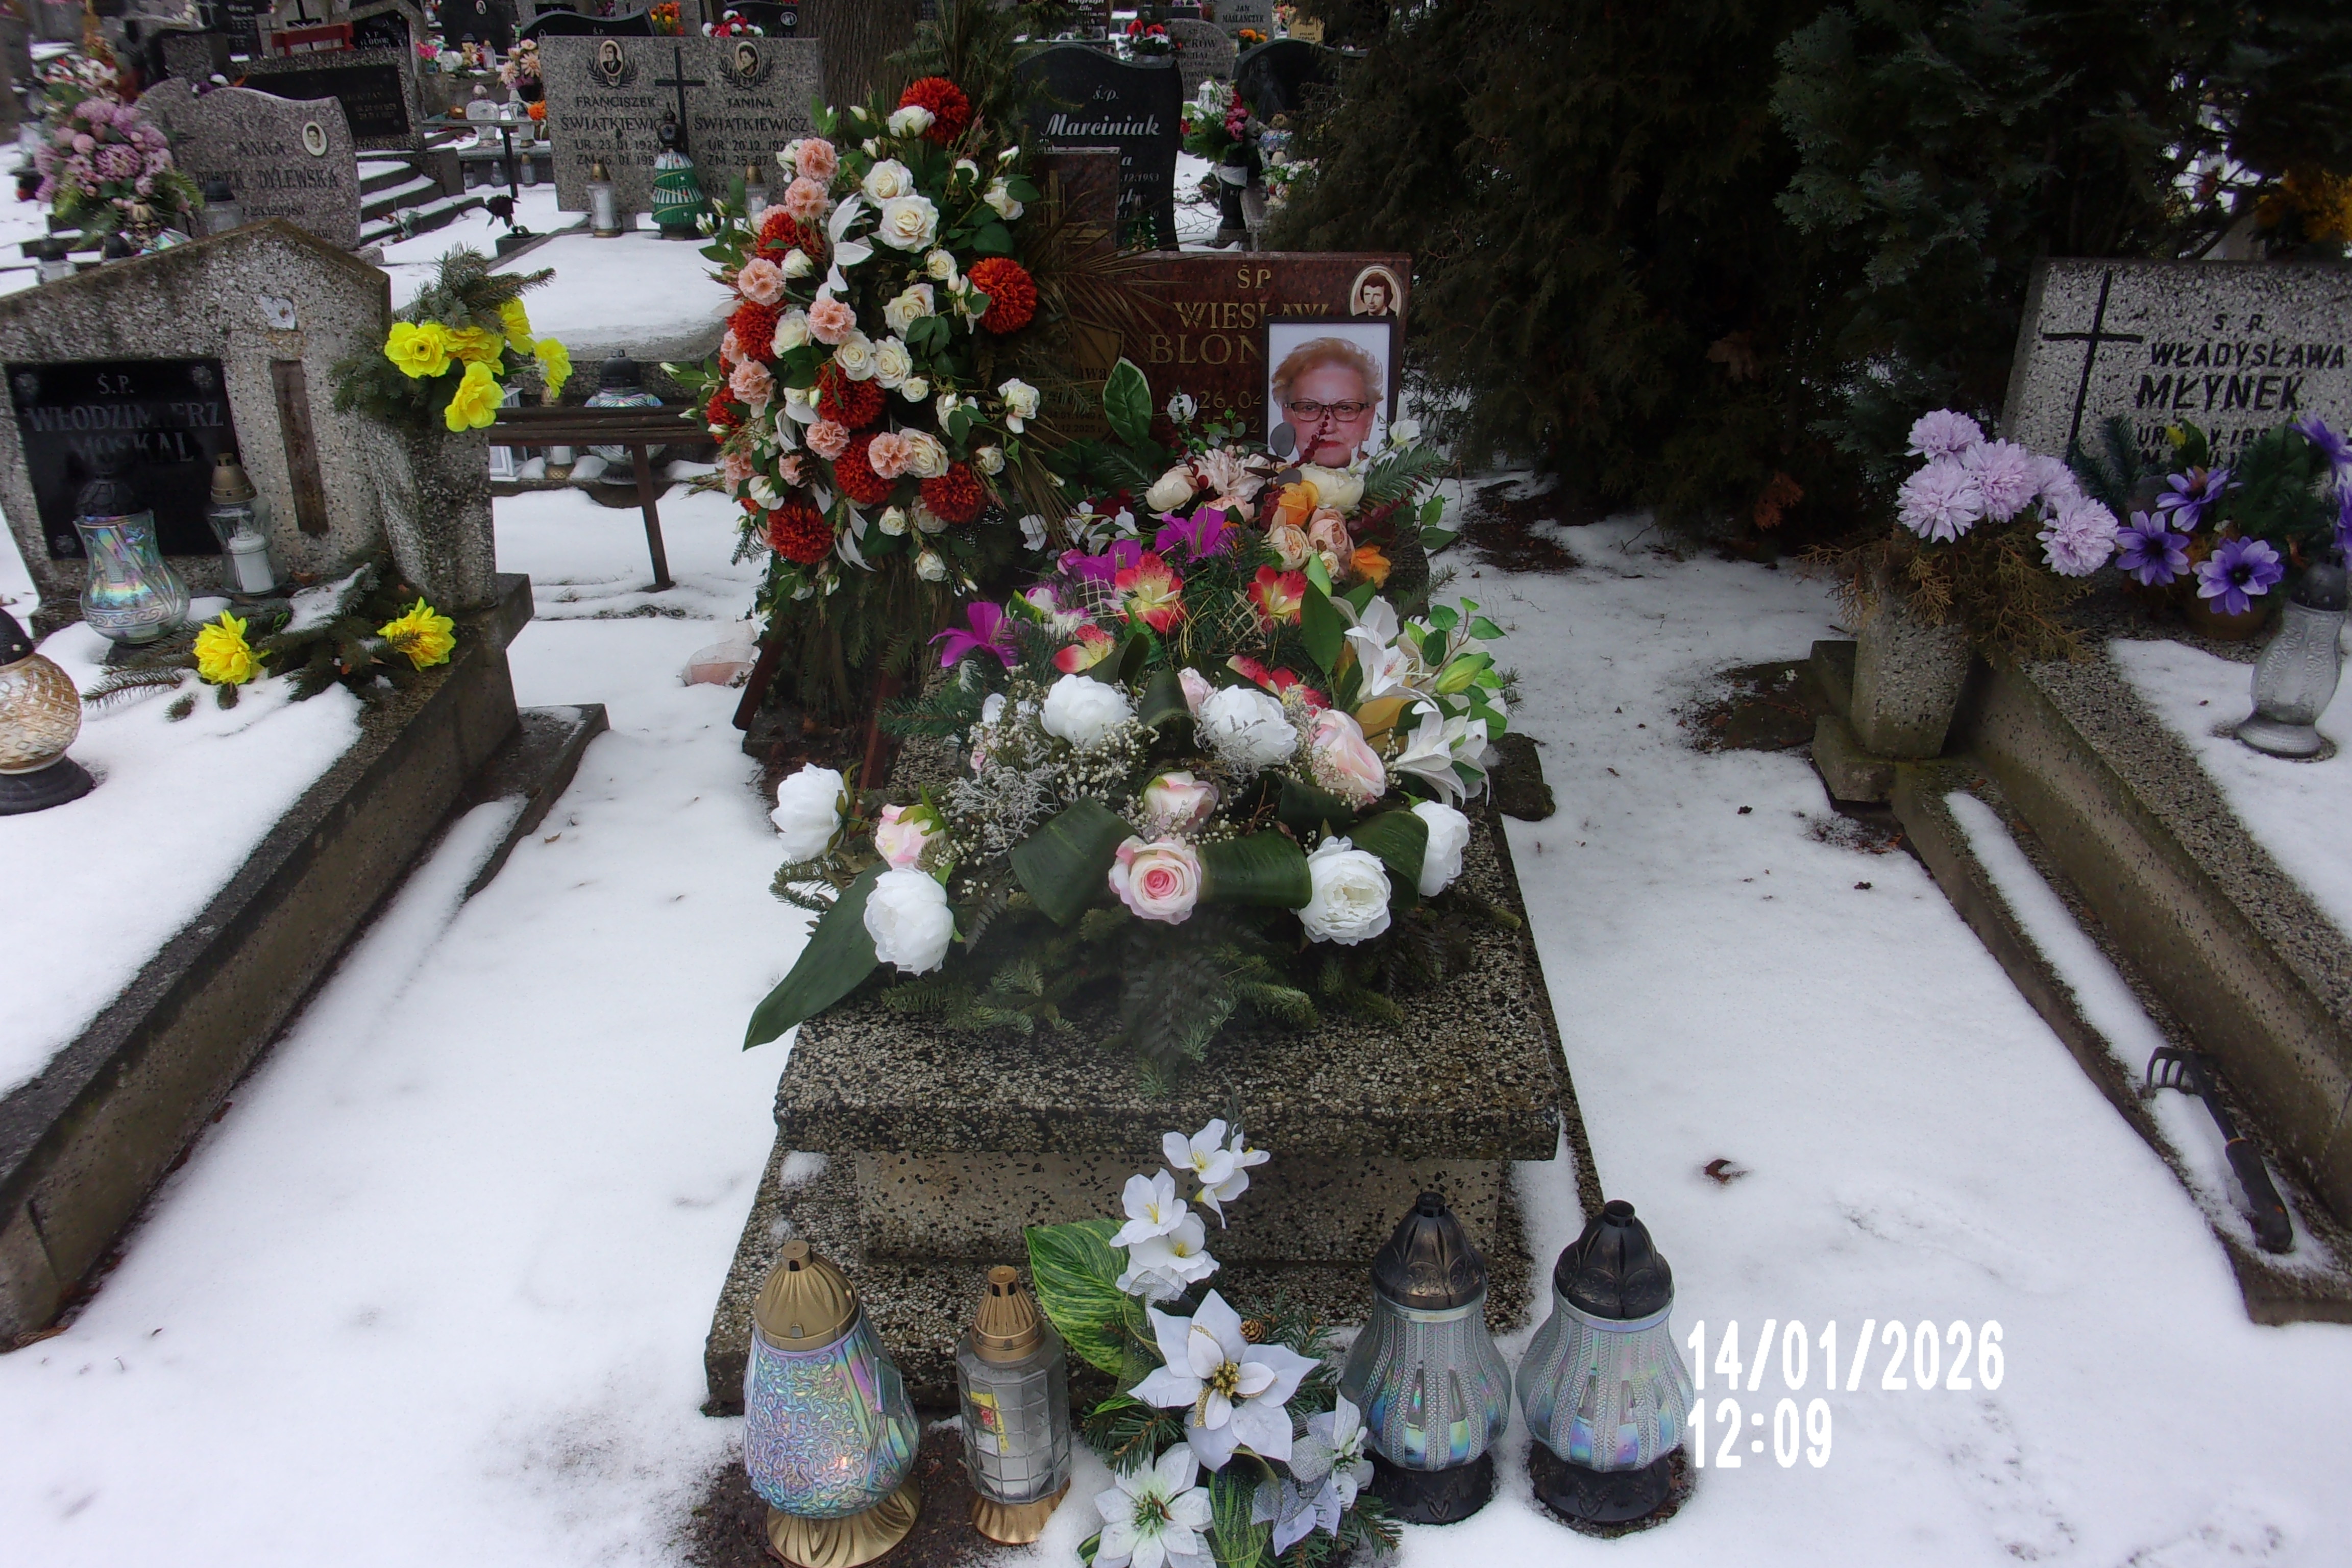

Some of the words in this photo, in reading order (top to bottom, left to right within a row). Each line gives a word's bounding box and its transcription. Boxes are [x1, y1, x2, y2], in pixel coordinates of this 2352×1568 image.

[576, 96, 656, 108] FRANCISZEK
[727, 97, 774, 108] JANINA
[1040, 113, 1160, 136] Marciniak
[238, 140, 287, 156] ANNA
[257, 167, 339, 188] DYLEWSKA
[1149, 333, 1264, 364] BLON
[2150, 338, 2344, 371] WŁADYSŁAWA
[2135, 374, 2306, 411] MŁYNEK
